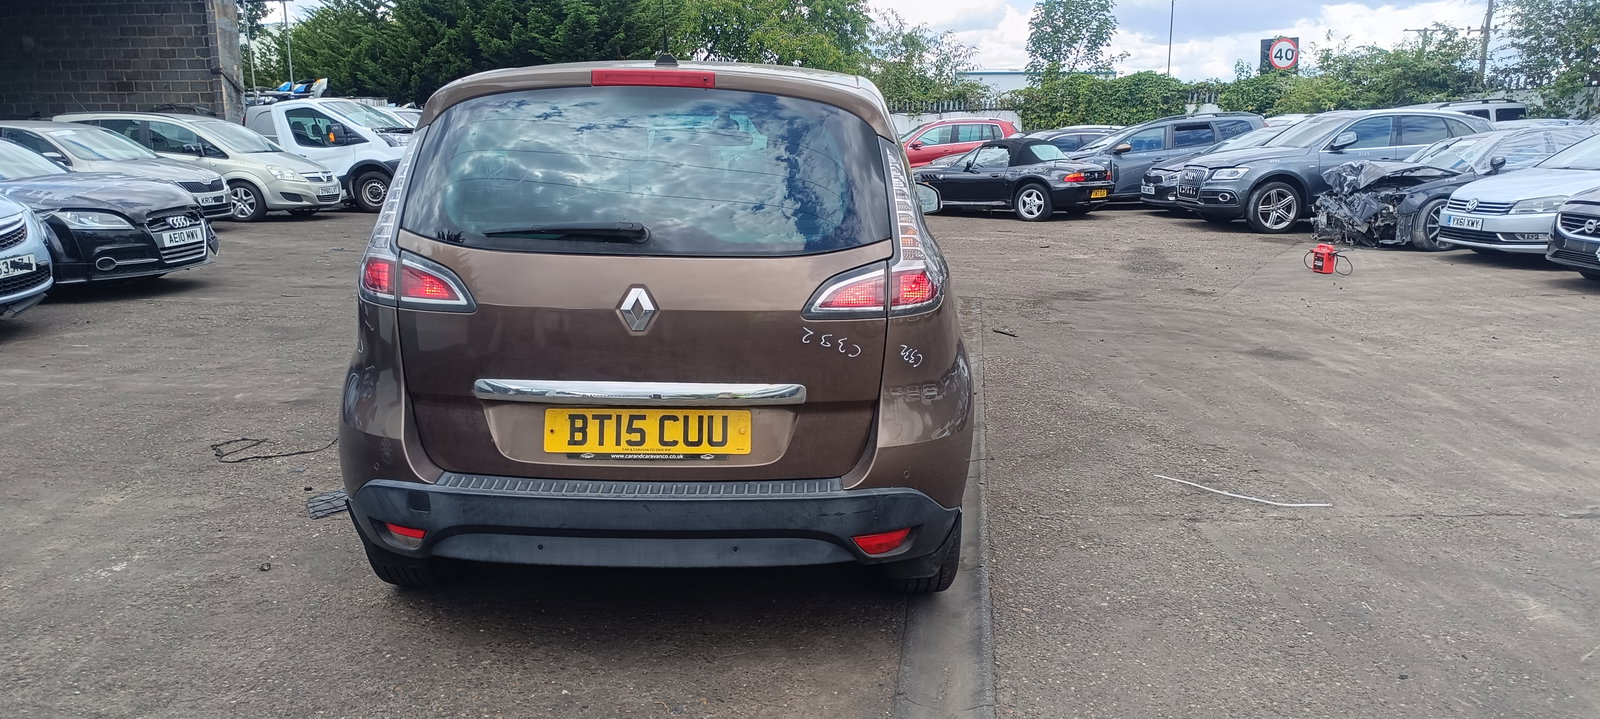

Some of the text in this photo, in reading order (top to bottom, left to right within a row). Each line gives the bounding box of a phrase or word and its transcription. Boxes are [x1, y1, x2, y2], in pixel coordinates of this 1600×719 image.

[1273, 48, 1295, 61] 40
[168, 231, 186, 244] AE10
[567, 413, 729, 448] BT15 CUU
